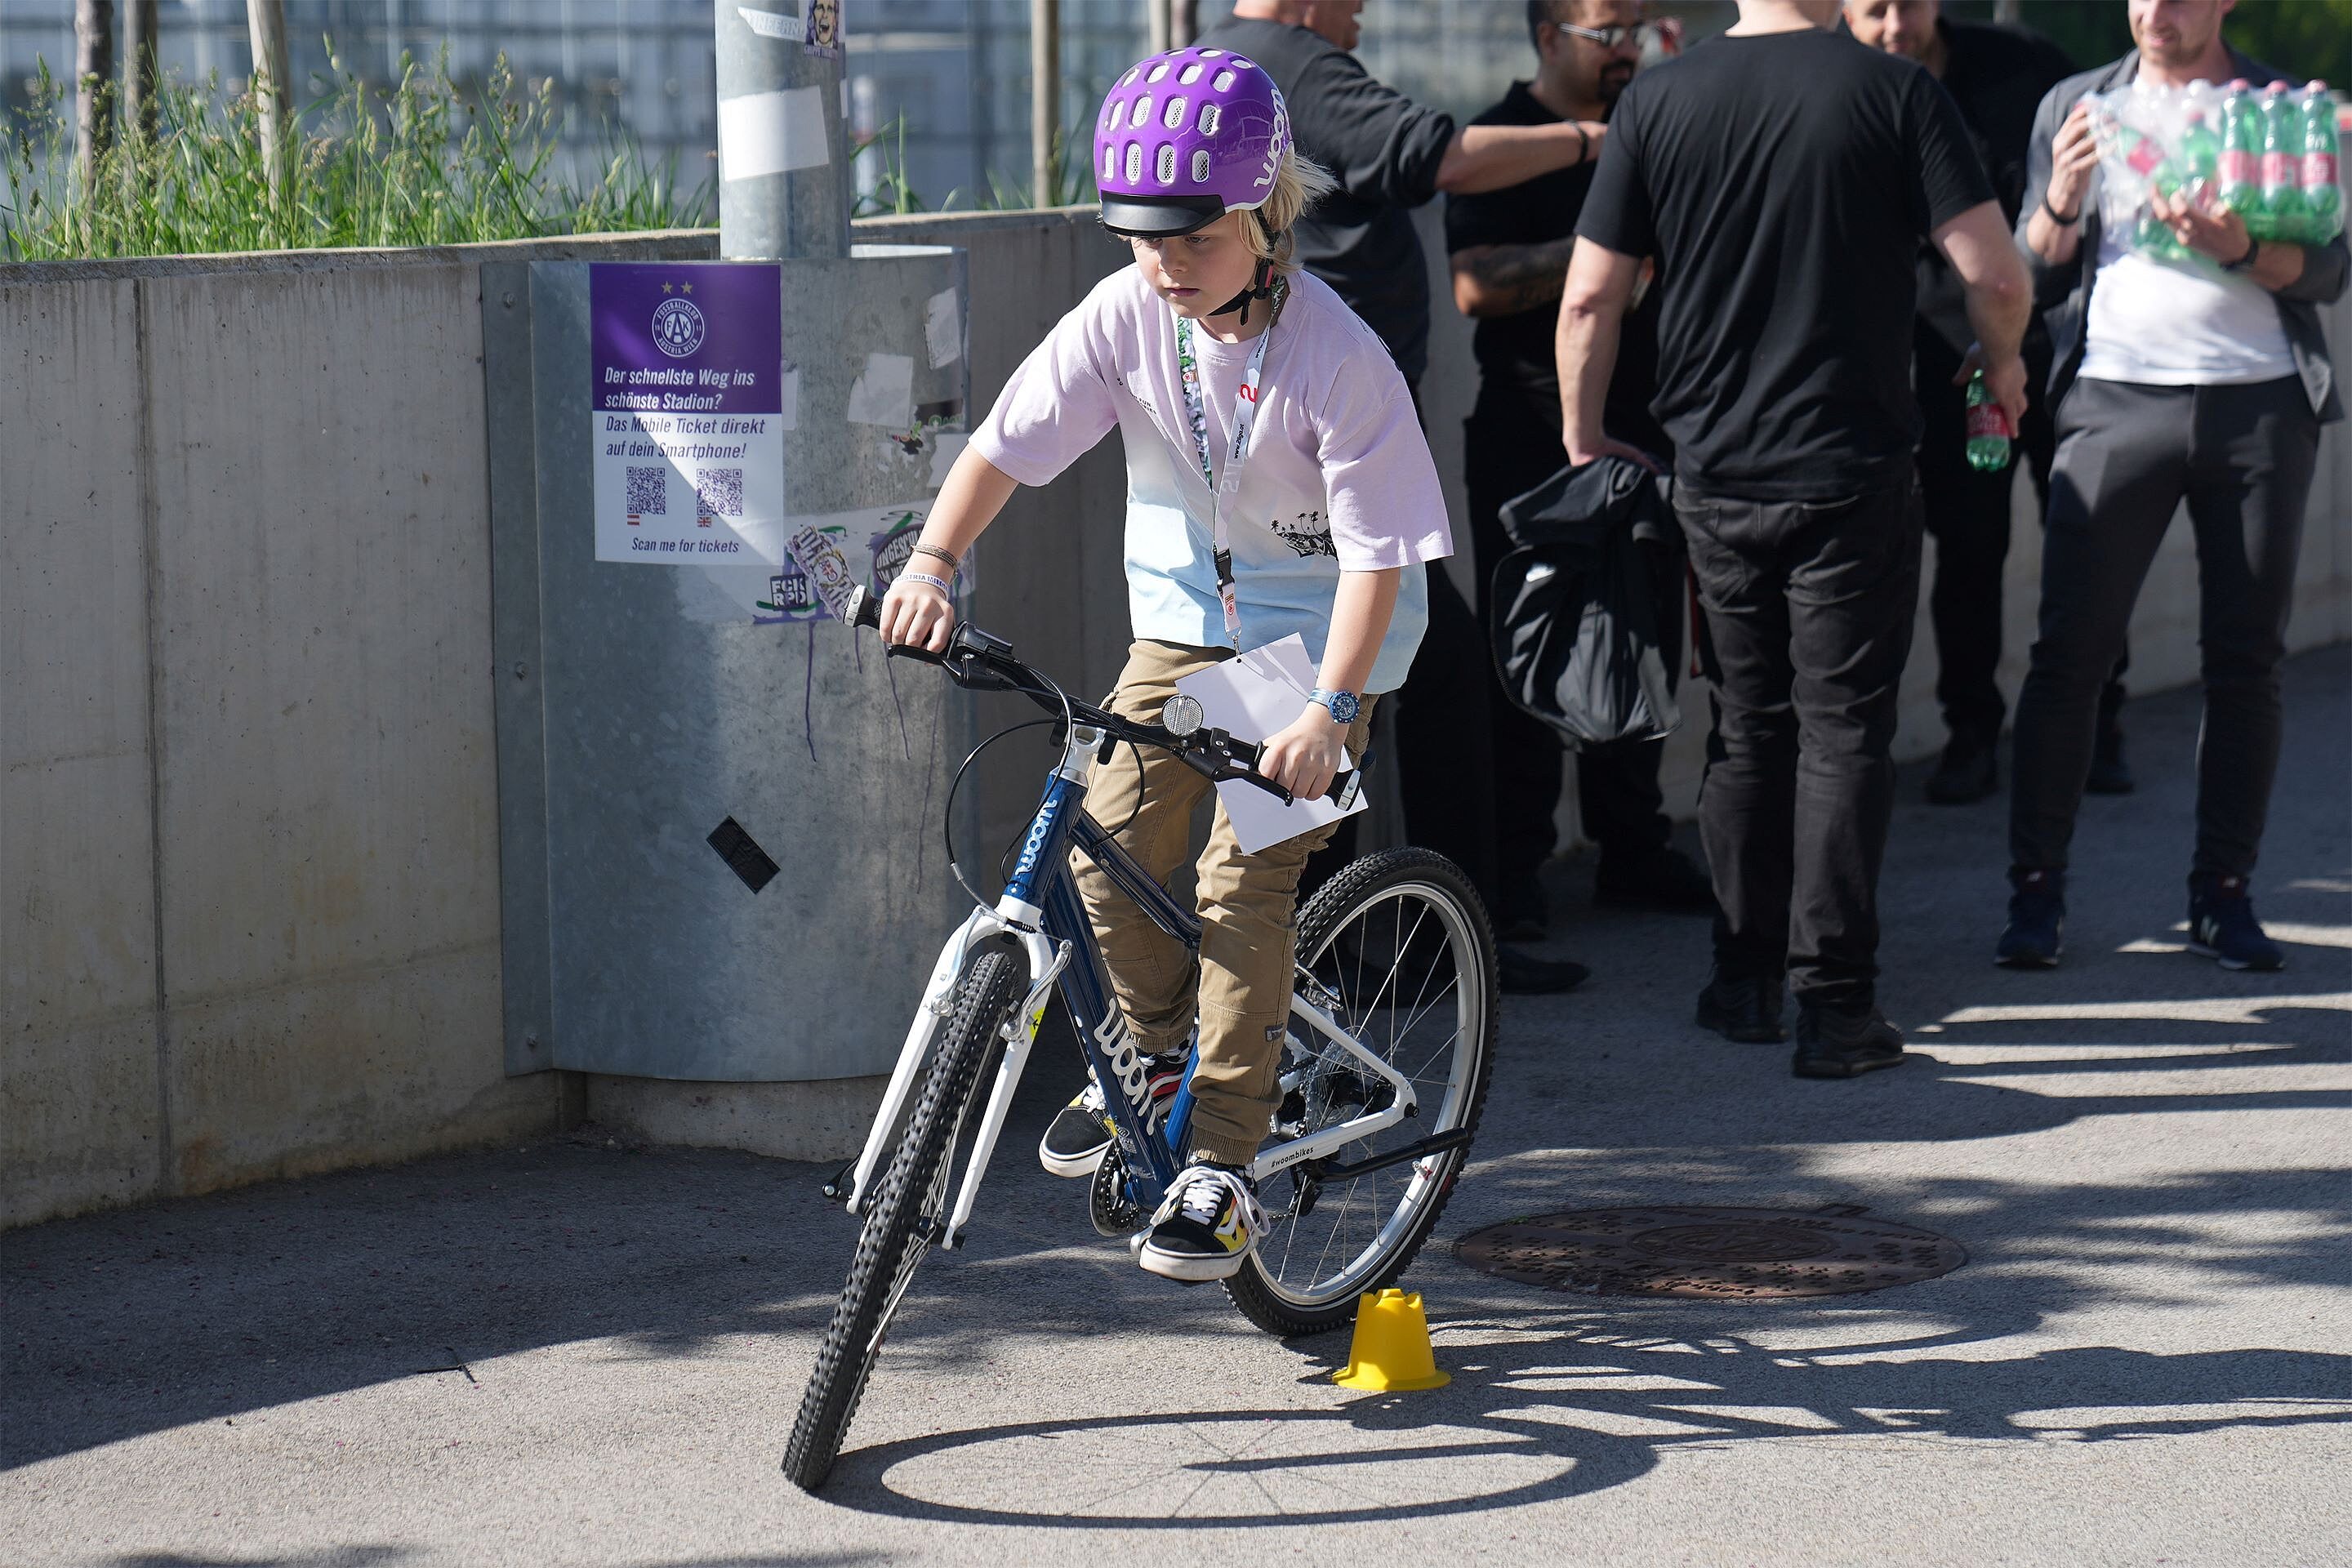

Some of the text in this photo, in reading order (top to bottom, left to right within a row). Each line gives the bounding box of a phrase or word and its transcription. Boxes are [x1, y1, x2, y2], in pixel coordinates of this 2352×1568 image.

[604, 367, 755, 389] Der schnellste Weg ins
[605, 392, 723, 410] schönste Stadion?
[606, 416, 765, 434] Das Mobile Ticket direkt
[606, 440, 747, 461] auf dein Smartphone!
[632, 537, 739, 553] Scan me for tickets
[771, 577, 805, 594] FCK
[773, 590, 807, 607] RPD
[1015, 799, 1058, 876] woom
[1094, 997, 1156, 1136] woom
[1271, 1147, 1314, 1168] #woombikes
